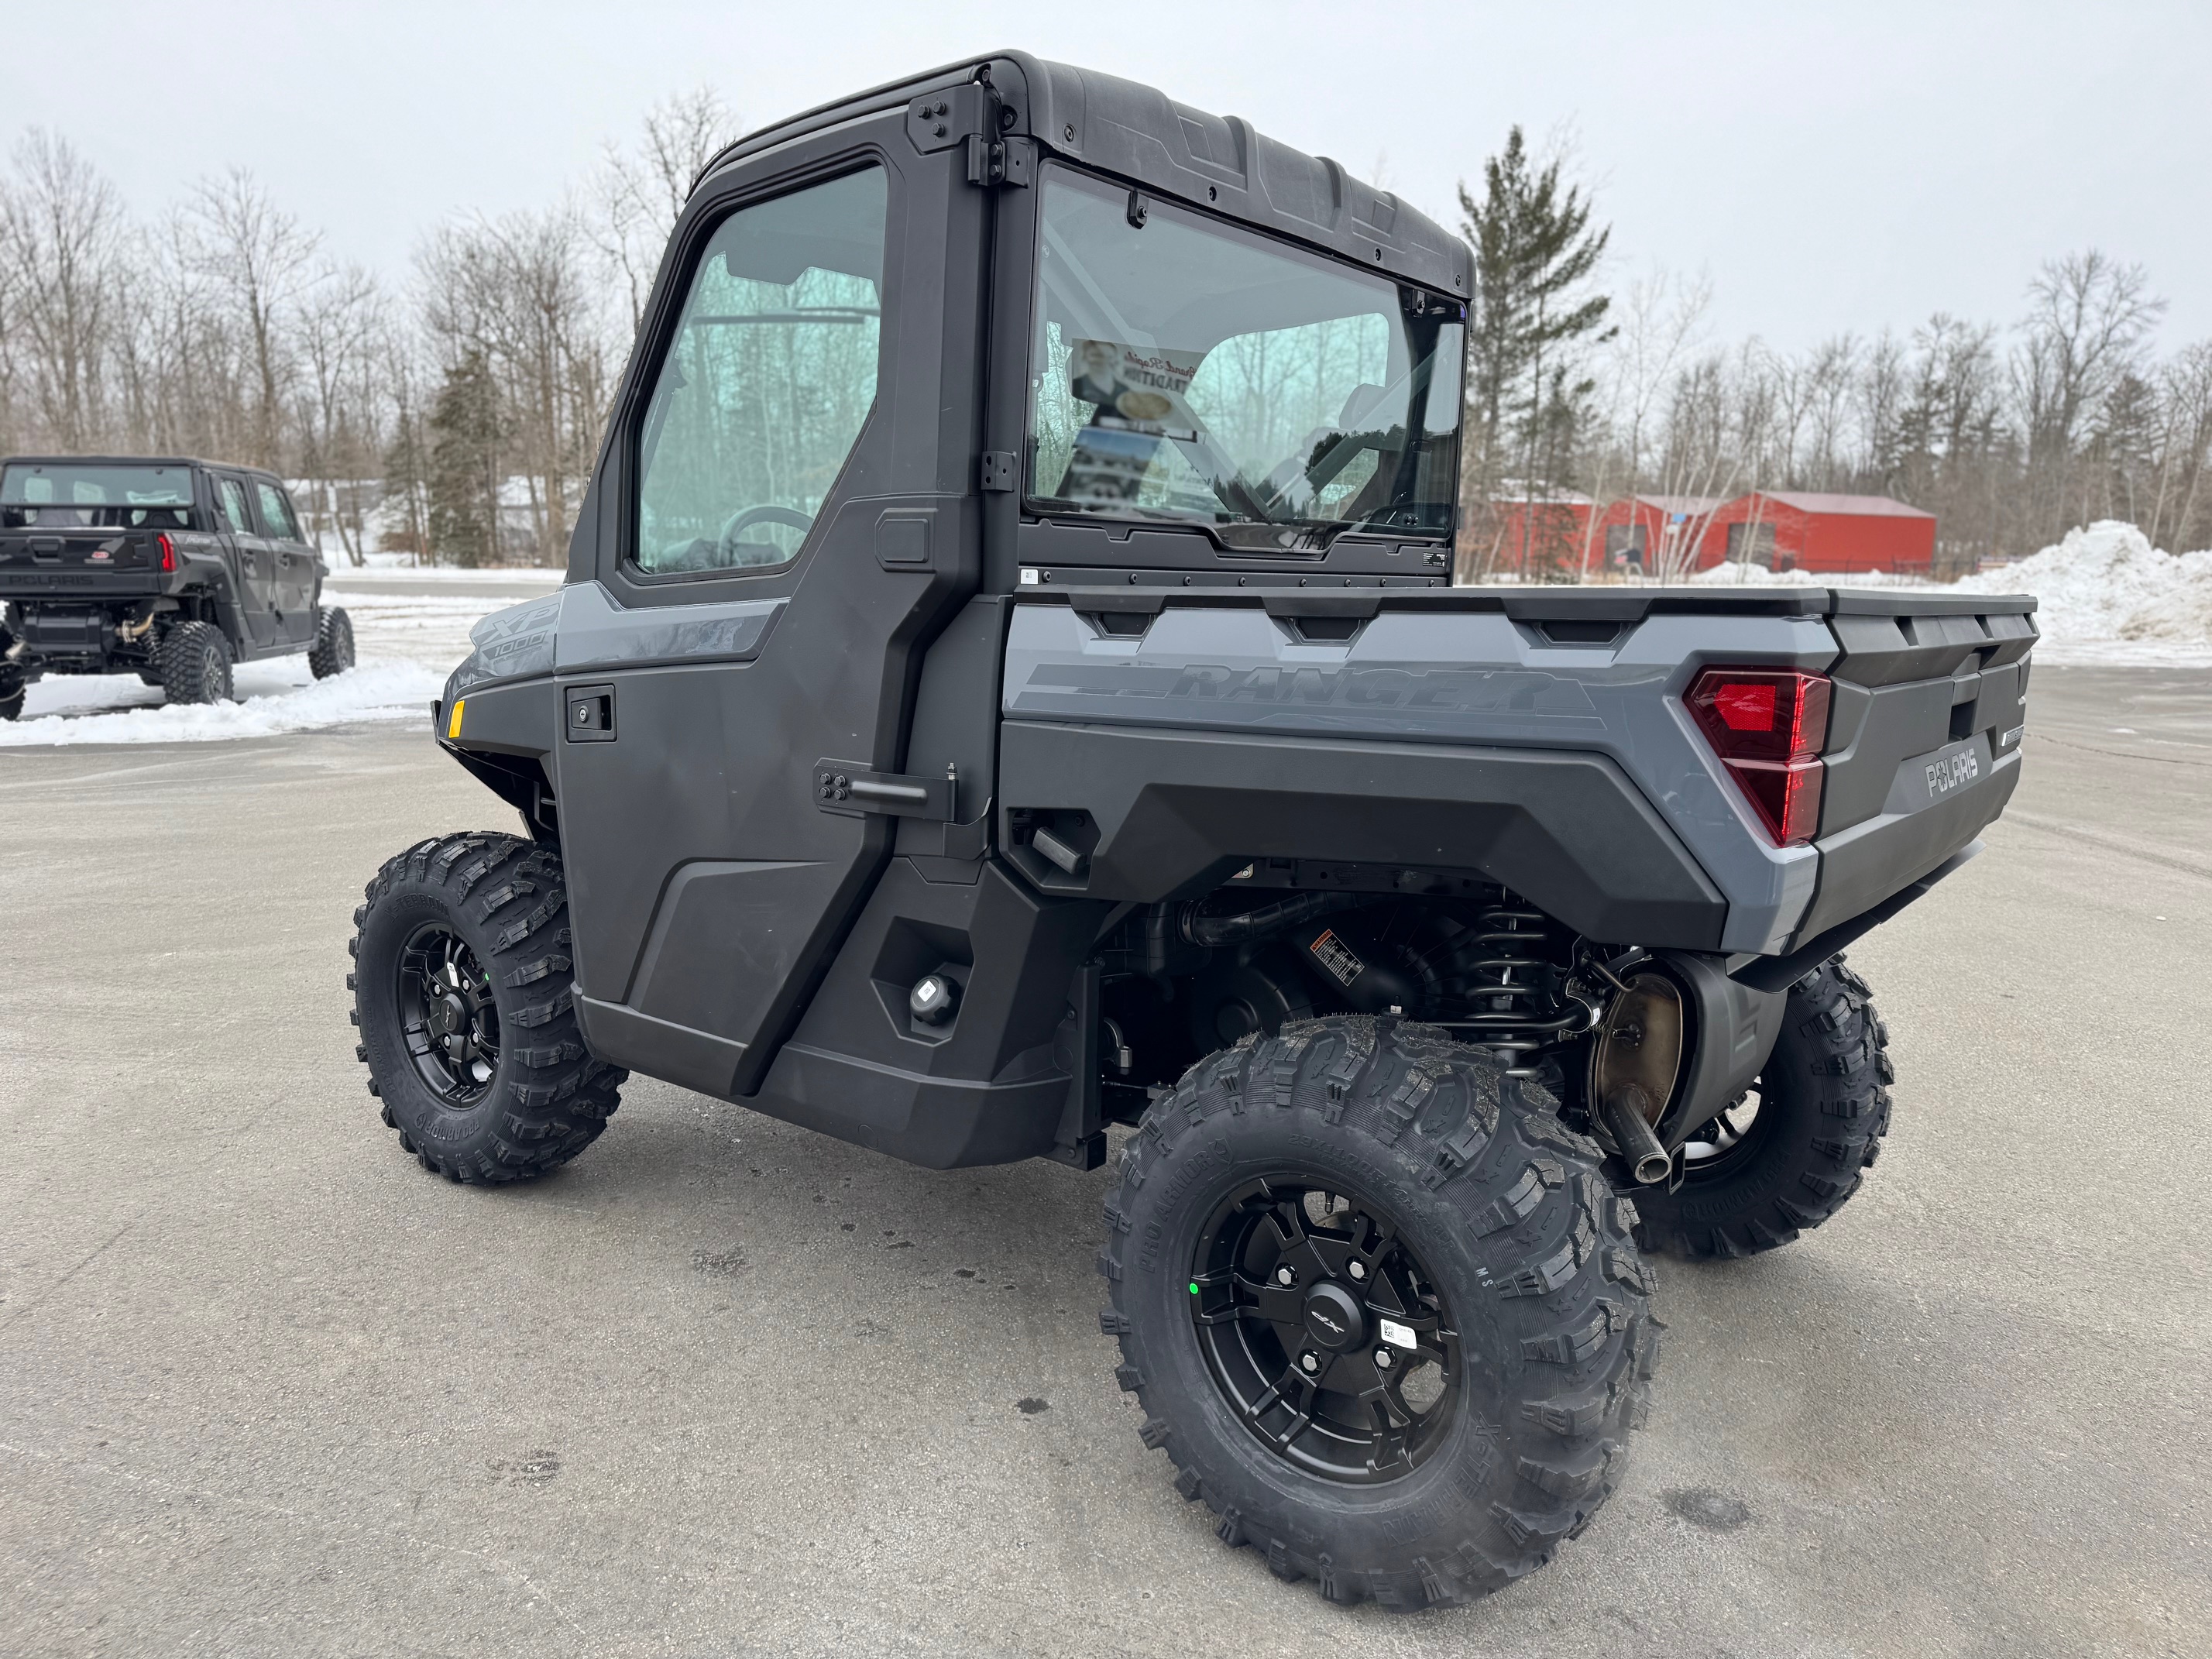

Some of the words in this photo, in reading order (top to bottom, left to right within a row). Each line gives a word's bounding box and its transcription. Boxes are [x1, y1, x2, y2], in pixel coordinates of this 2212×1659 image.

[9, 575, 94, 586] POLARIS
[480, 602, 560, 645] XP
[494, 631, 547, 658] 1000
[1166, 664, 1555, 715] RANGER
[1925, 748, 1978, 797] POLARIS
[1139, 1220, 1163, 1274] PRO
[1152, 1149, 1214, 1222] ARMOR
